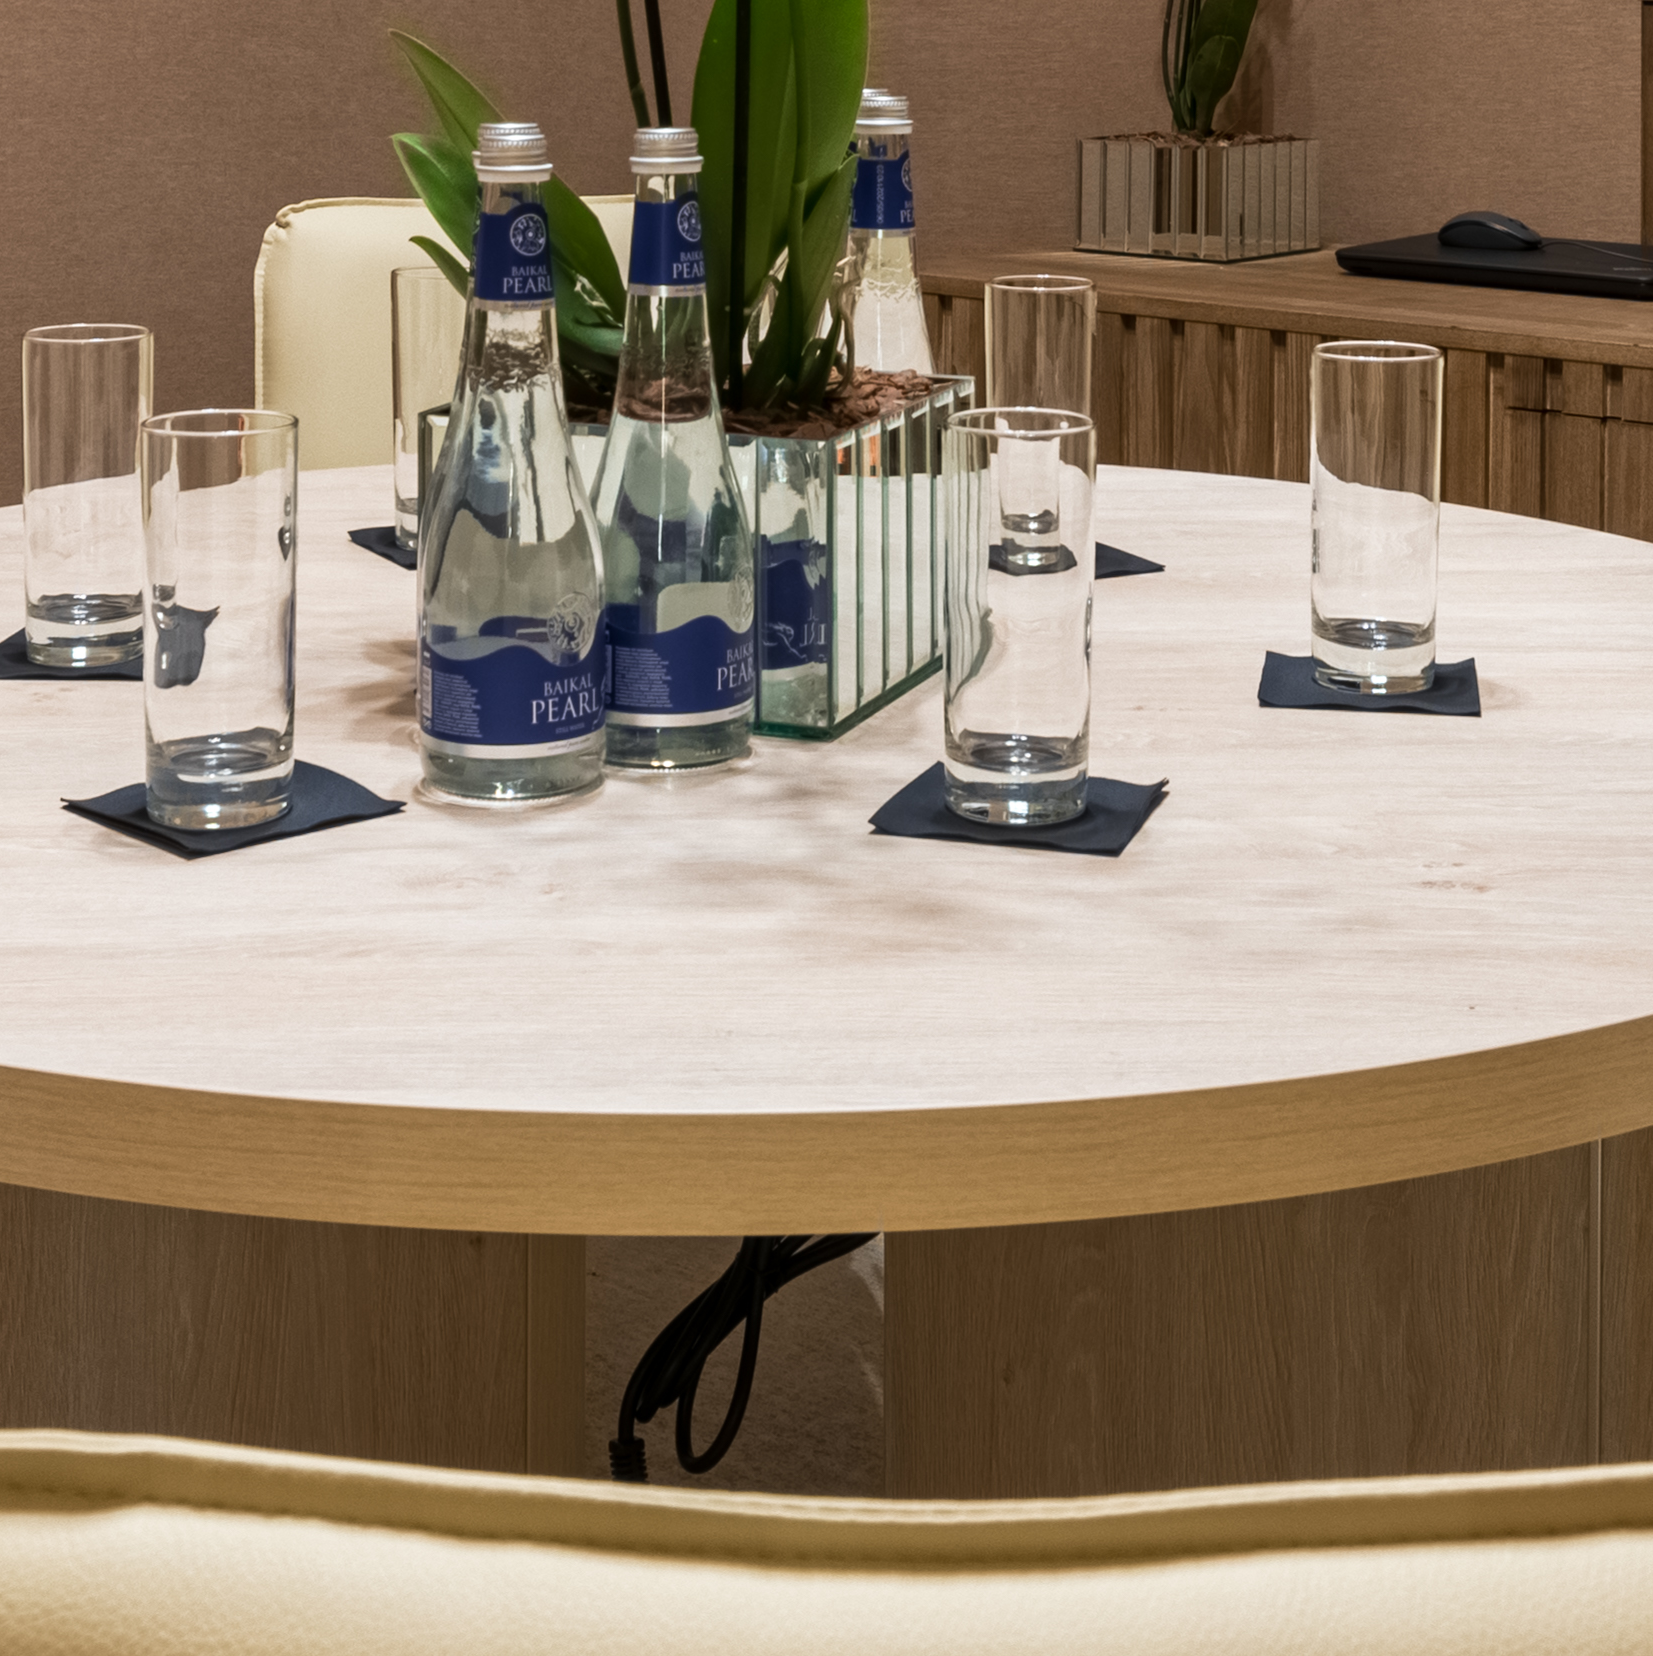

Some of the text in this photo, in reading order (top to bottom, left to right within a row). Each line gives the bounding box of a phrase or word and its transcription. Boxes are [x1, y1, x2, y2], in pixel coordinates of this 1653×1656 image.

[512, 265, 547, 276] BAIKAL
[673, 260, 705, 279] PEAR
[503, 275, 552, 294] PEARL
[717, 656, 754, 691] PEAR
[544, 673, 593, 697] BAIKAL
[531, 687, 600, 724] PEARL
